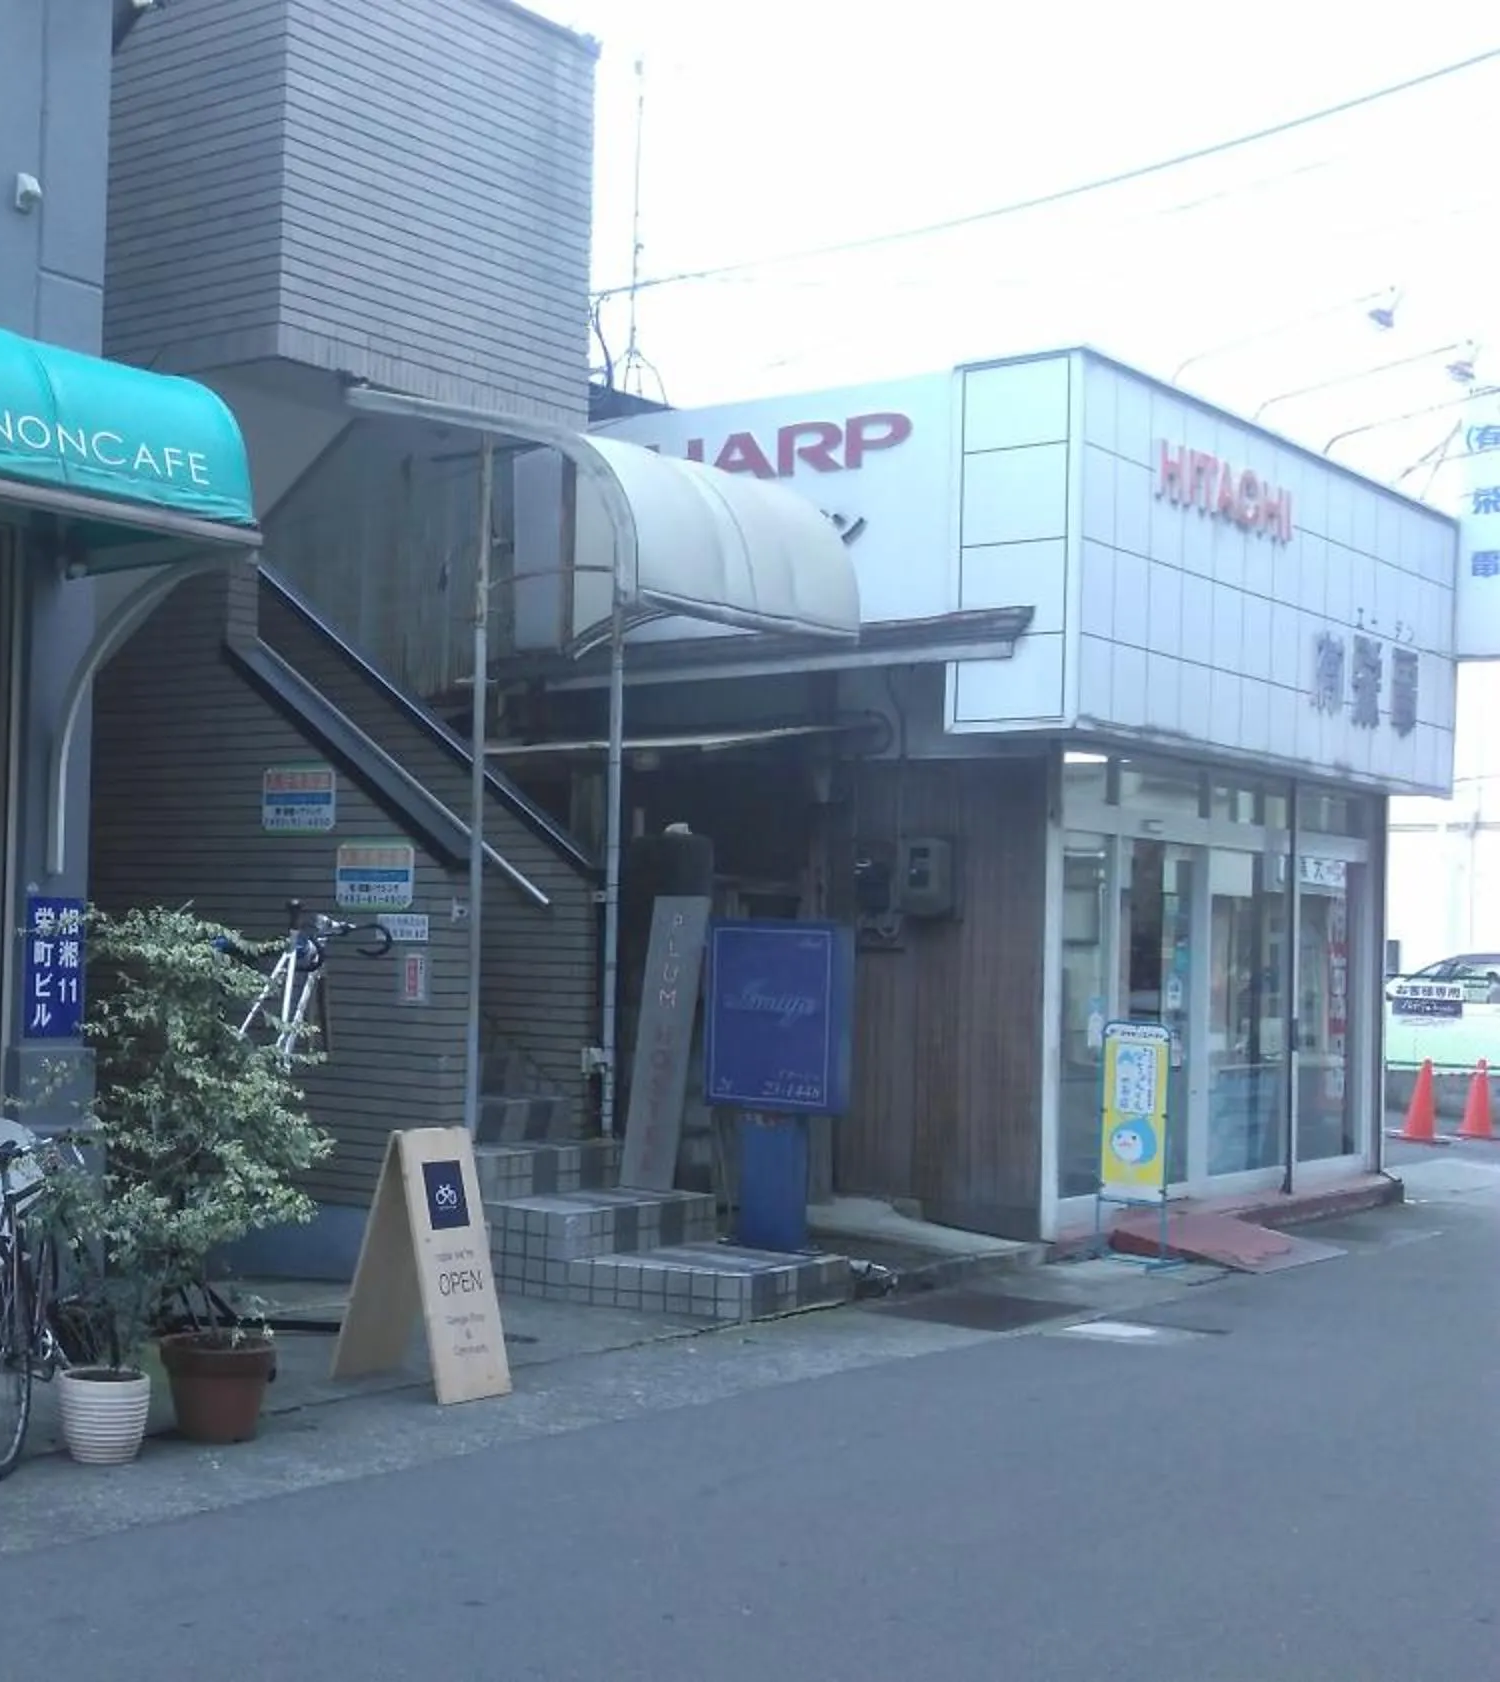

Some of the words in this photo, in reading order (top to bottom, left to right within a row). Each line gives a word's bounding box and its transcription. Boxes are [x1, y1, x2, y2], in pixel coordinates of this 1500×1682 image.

[645, 412, 913, 479] ARP
[1159, 438, 1293, 544] HITACHI
[658, 912, 684, 1009] PLUM
[439, 1269, 484, 1297] OPEN
